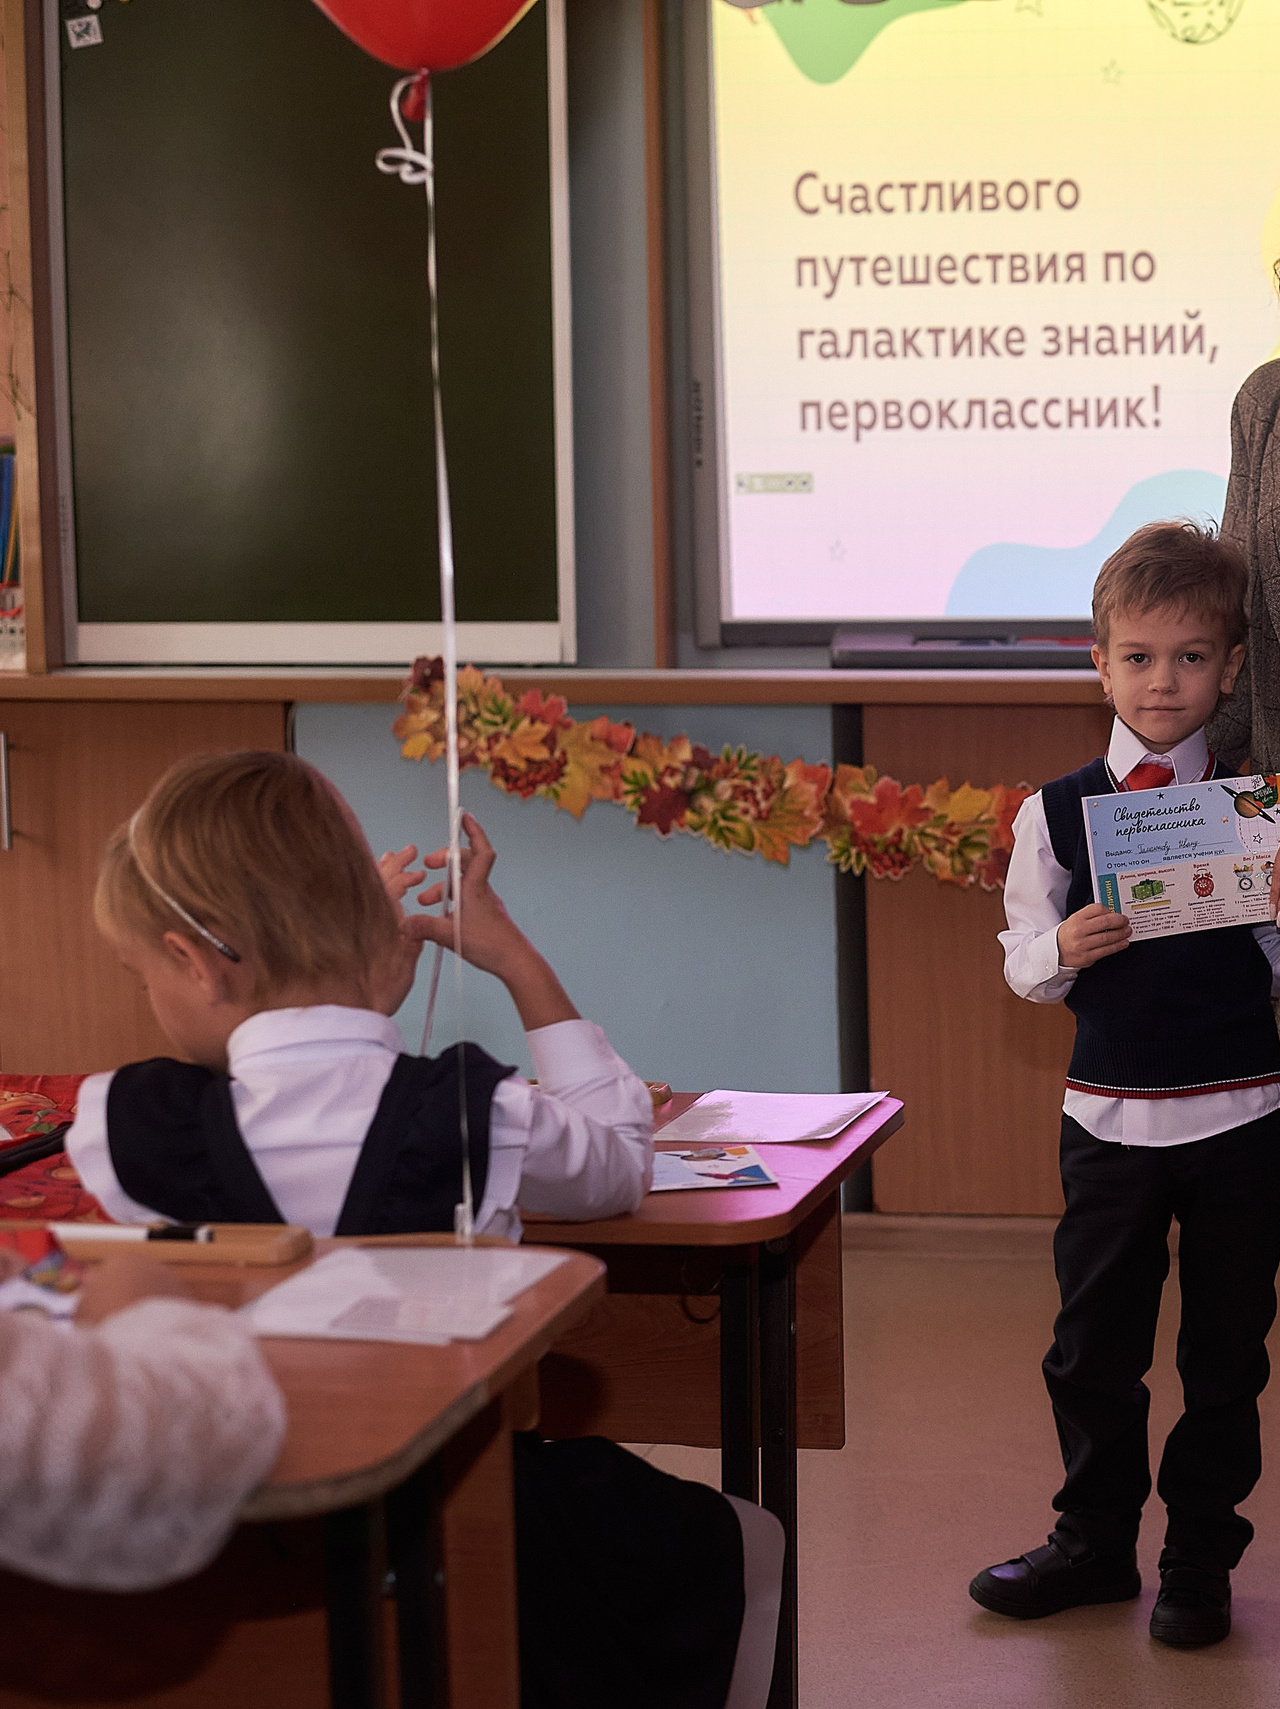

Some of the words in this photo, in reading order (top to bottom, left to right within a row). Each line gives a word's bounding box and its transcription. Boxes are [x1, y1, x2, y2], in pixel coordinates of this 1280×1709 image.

[793, 171, 1081, 215] Счастливого
[797, 252, 1086, 299] путешествия
[1103, 250, 1156, 284] по
[798, 324, 1027, 360] галактике
[1041, 309, 1219, 364] знаний,
[800, 384, 1162, 443] первоклассник!
[1113, 797, 1201, 822] Свидетельство
[1115, 818, 1206, 842] первоклассника
[1162, 853, 1192, 861] является
